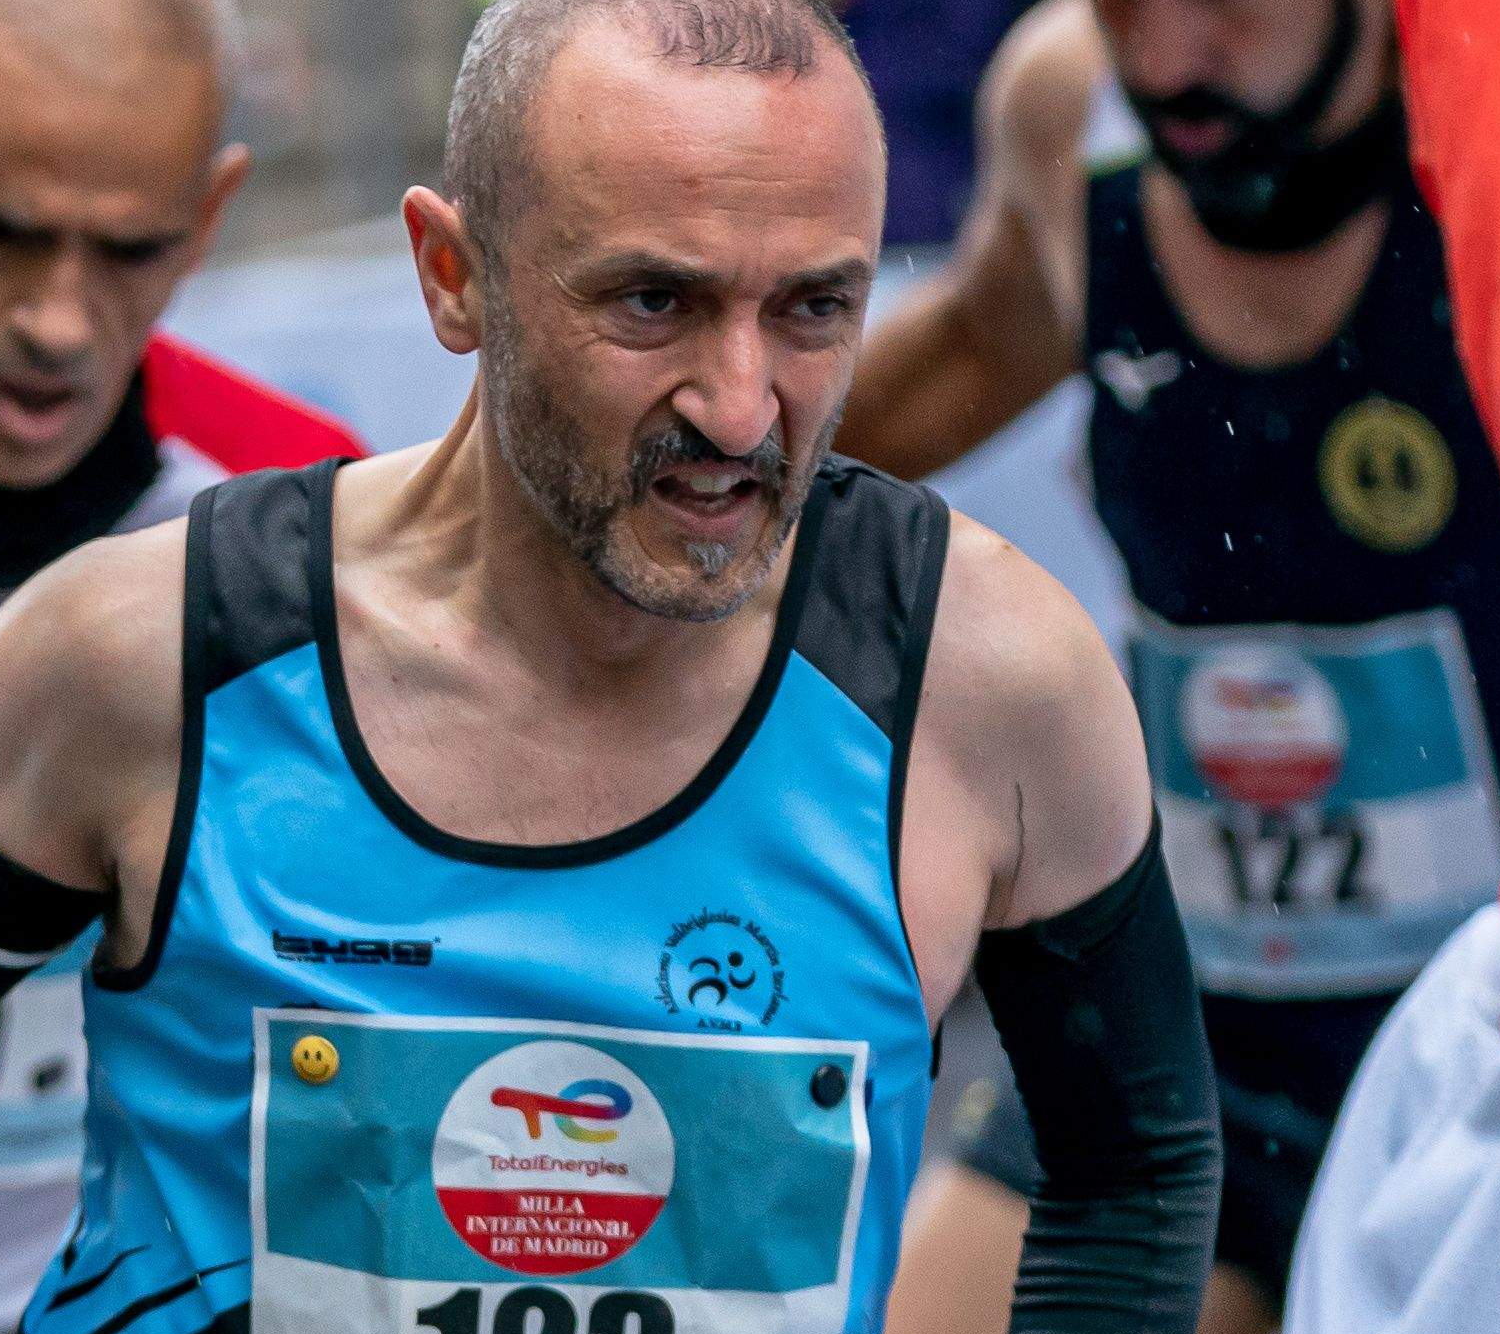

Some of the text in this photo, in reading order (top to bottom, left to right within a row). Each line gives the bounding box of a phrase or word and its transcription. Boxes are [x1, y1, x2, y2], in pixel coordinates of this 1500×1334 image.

[1212, 807, 1386, 913] 122
[488, 1153, 629, 1178] TotalEnergies
[519, 1195, 585, 1215] MILLA
[466, 1216, 636, 1239] INTERNACIONAL
[490, 1236, 609, 1257] DE MADRID
